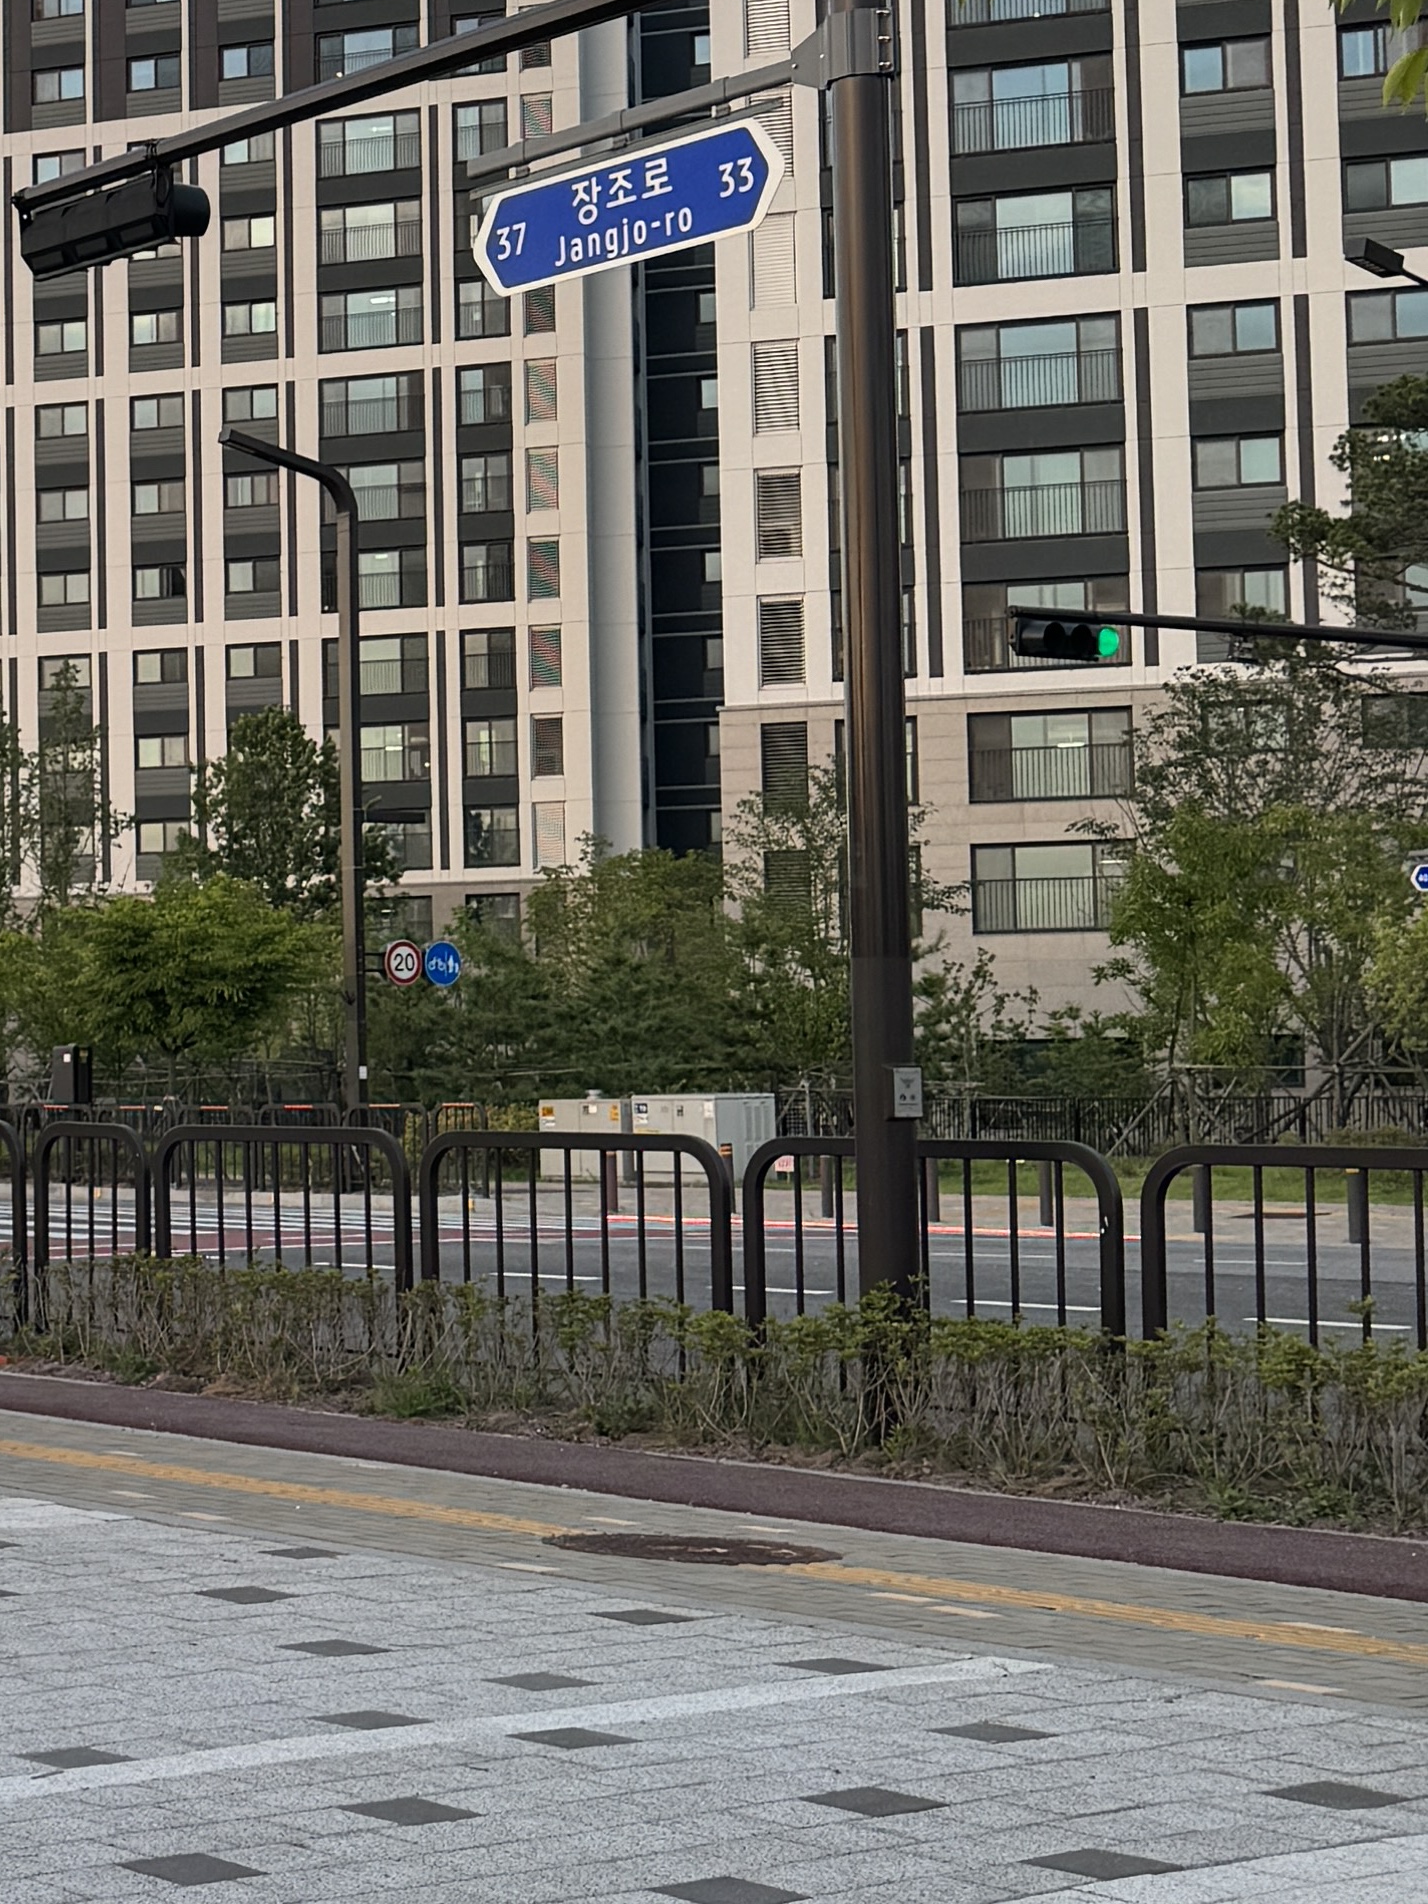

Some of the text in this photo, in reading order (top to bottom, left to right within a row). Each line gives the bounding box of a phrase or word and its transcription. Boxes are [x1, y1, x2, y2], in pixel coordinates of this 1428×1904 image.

[571, 156, 674, 226] 장조로
[718, 156, 755, 198] 33
[495, 221, 527, 262] 37
[554, 206, 693, 268] Jangjo-ro
[394, 953, 415, 972] 20
